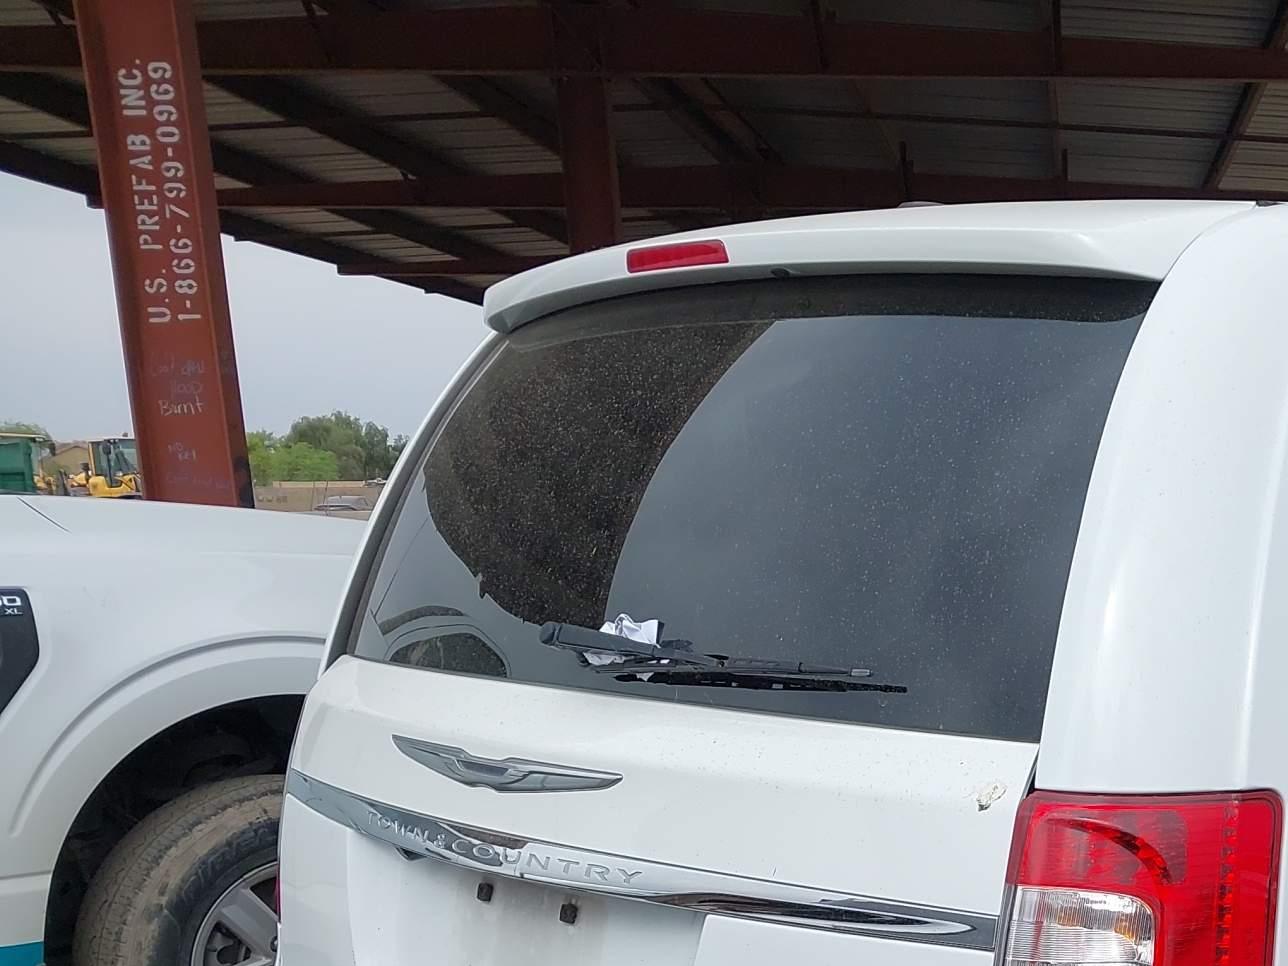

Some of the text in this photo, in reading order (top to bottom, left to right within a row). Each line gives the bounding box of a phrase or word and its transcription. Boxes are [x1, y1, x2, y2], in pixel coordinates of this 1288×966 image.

[118, 59, 172, 323] U.S. PREFAB INC.
[147, 61, 202, 321] 1-866-799-0969
